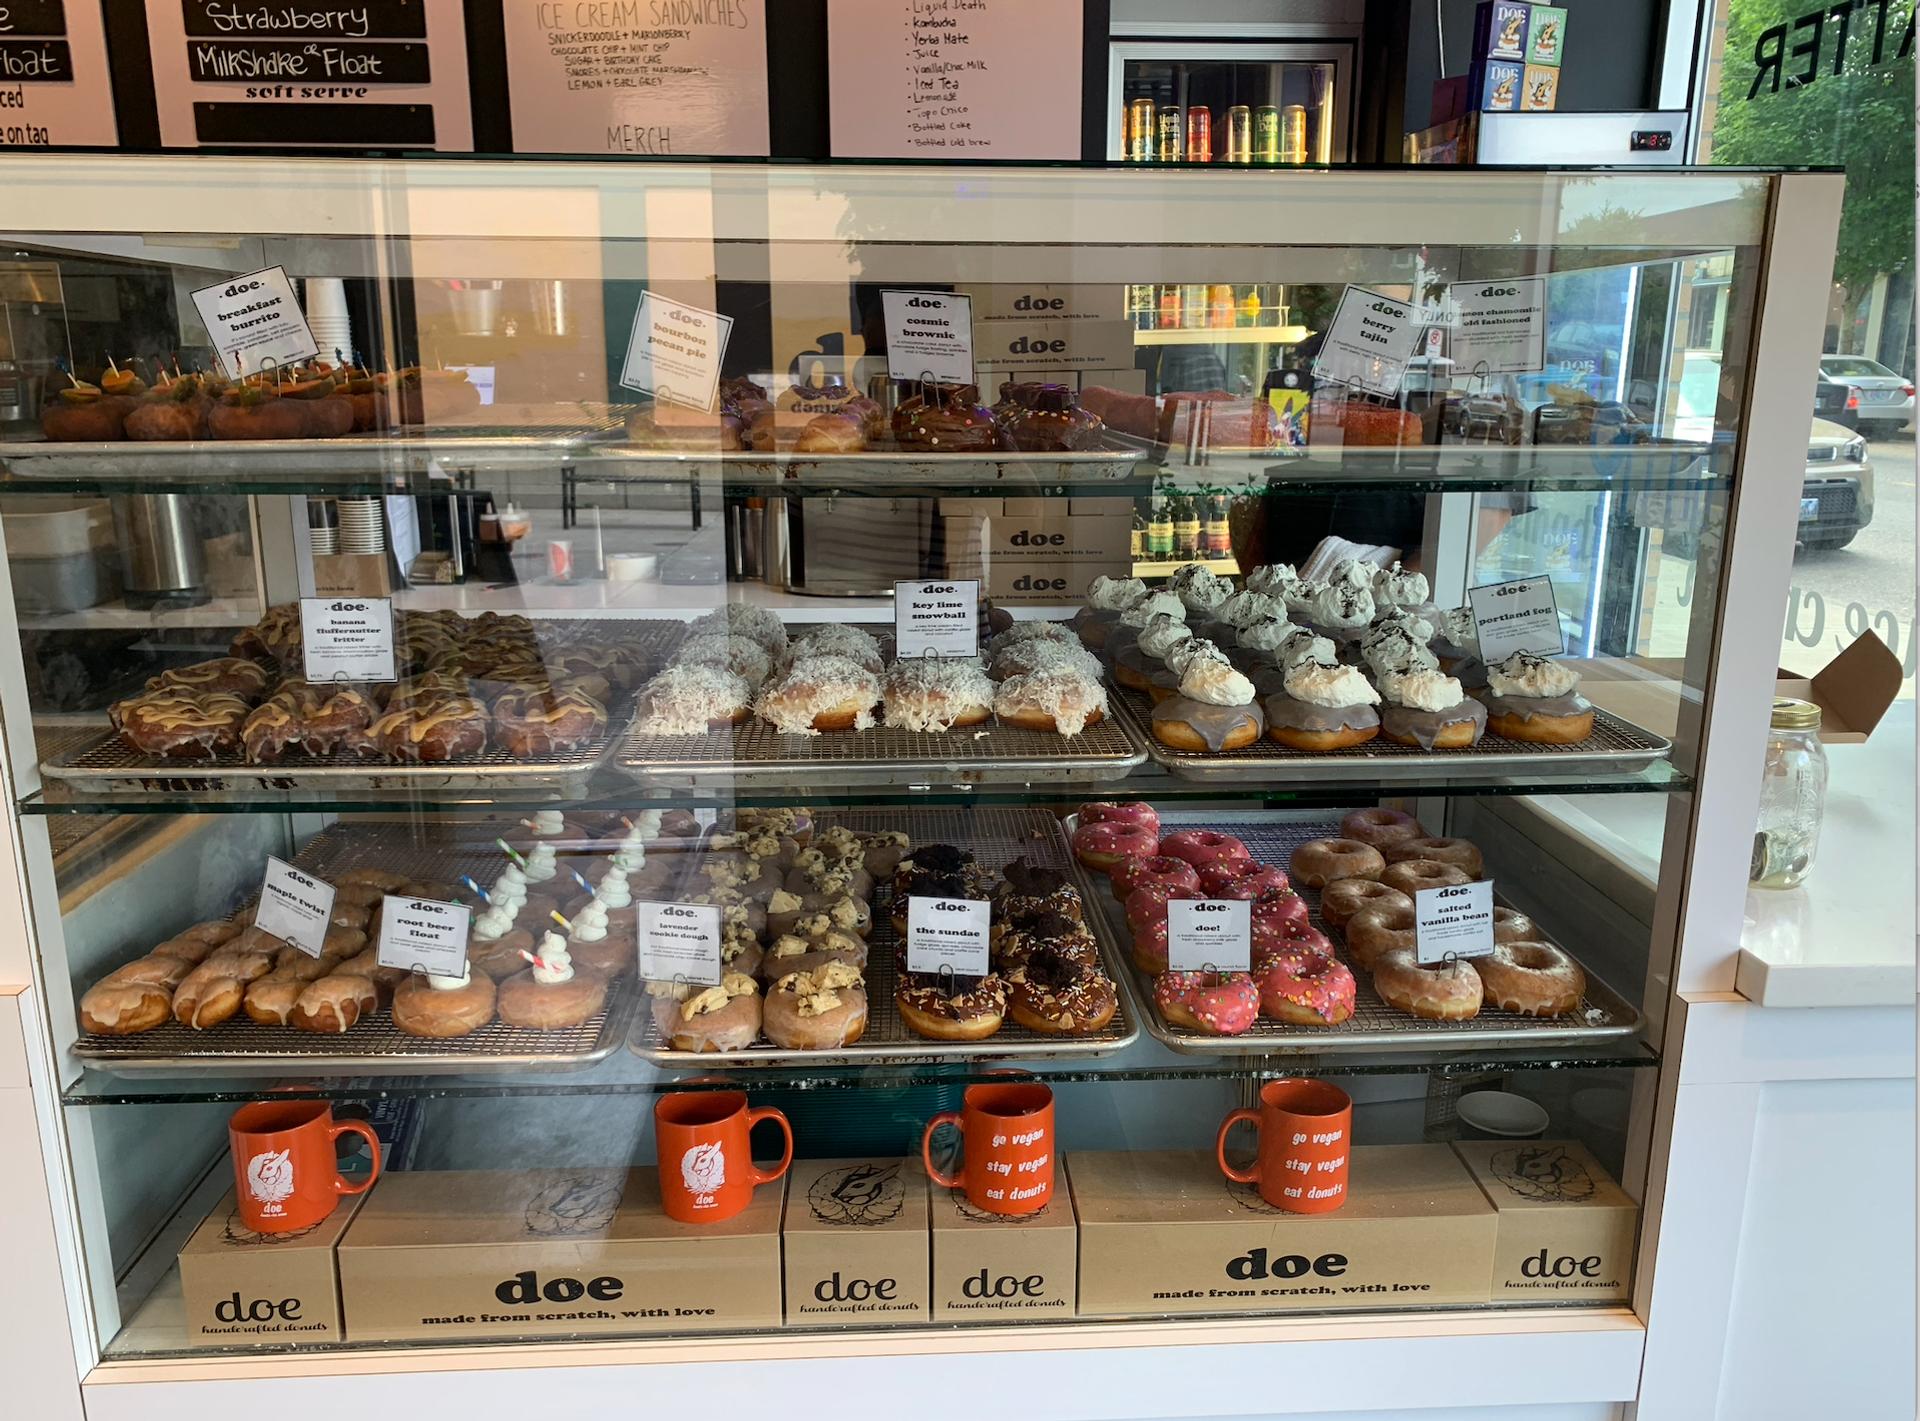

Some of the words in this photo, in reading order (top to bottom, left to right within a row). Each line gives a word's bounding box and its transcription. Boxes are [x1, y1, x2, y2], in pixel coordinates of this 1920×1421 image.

[206, 3, 369, 36] Strawberry
[536, 3, 564, 30] ICE
[576, 0, 639, 28] CREAM
[650, 0, 749, 29] SANDWICHES
[1498, 7, 1526, 23] DOE
[912, 31, 939, 46] Yerba
[943, 32, 969, 44] Mate
[322, 48, 383, 77] Float
[912, 49, 939, 60] Juice
[568, 79, 603, 91] LEMON
[639, 77, 664, 87] GREY
[938, 77, 959, 90] Tea
[246, 85, 294, 99] soft
[301, 86, 368, 98] serve
[7, 127, 24, 144] on
[607, 125, 671, 153] MERCH
[217, 296, 283, 322] breakfast
[1014, 295, 1064, 311] doe
[230, 312, 280, 331] burrito
[906, 318, 950, 326] cosmic
[1362, 317, 1396, 333] berry
[1481, 316, 1531, 325] fashioned
[654, 322, 707, 346] bourbon
[903, 329, 955, 339] brownie
[1360, 329, 1388, 344] tajin
[647, 335, 684, 352] pecan
[686, 348, 706, 359] pie
[1009, 336, 1066, 354] doe
[1010, 530, 1065, 546] doe
[1013, 575, 1067, 591] doe
[912, 602, 934, 610] key
[1479, 610, 1530, 626] portland
[1533, 607, 1552, 615] fog
[267, 883, 297, 901] maple
[299, 898, 326, 916] twist
[1438, 903, 1472, 914] salted
[397, 919, 424, 927] root
[427, 922, 455, 931] beer
[660, 923, 698, 931] lavender
[1422, 916, 1460, 927] vanilla
[1463, 912, 1489, 920] bean
[410, 930, 440, 939] float
[681, 933, 709, 941] dough
[992, 1135, 1006, 1147] go
[1012, 1128, 1044, 1146] vegan
[1292, 1133, 1306, 1145] go
[1312, 1129, 1342, 1146] vegan
[986, 1161, 1012, 1176] stay
[1018, 1154, 1048, 1173] vegan
[1285, 1159, 1311, 1175] stay
[1317, 1156, 1344, 1173] vegan
[696, 1194, 714, 1204] doe
[986, 1188, 1004, 1200] eat
[1009, 1182, 1047, 1200] donuts
[1284, 1187, 1302, 1198] eat
[1307, 1184, 1343, 1199] donuts
[263, 1202, 282, 1213] doe
[1226, 1248, 1348, 1280] doe
[1521, 1248, 1602, 1278] doe
[495, 1270, 624, 1304] doe
[814, 1272, 897, 1301] doe
[962, 1268, 1044, 1298] doe
[1153, 1289, 1204, 1299] made
[1208, 1288, 1256, 1297] from
[1261, 1285, 1336, 1296] scratch,
[1341, 1284, 1387, 1294] with
[1392, 1283, 1430, 1292] love
[1504, 1280, 1579, 1290] handcrafted
[1581, 1280, 1620, 1288] donuts
[215, 1292, 302, 1322] doe
[800, 1304, 877, 1314] handcrafted
[878, 1302, 920, 1311] donuts
[947, 1301, 1023, 1310] handcrafted
[1025, 1298, 1066, 1308] donuts
[422, 1314, 476, 1324] made
[480, 1312, 531, 1322] from
[536, 1309, 616, 1321] scratch,
[621, 1308, 669, 1318] with
[674, 1307, 716, 1317] love
[202, 1324, 281, 1334] handcrafted
[284, 1322, 328, 1332] donuts
